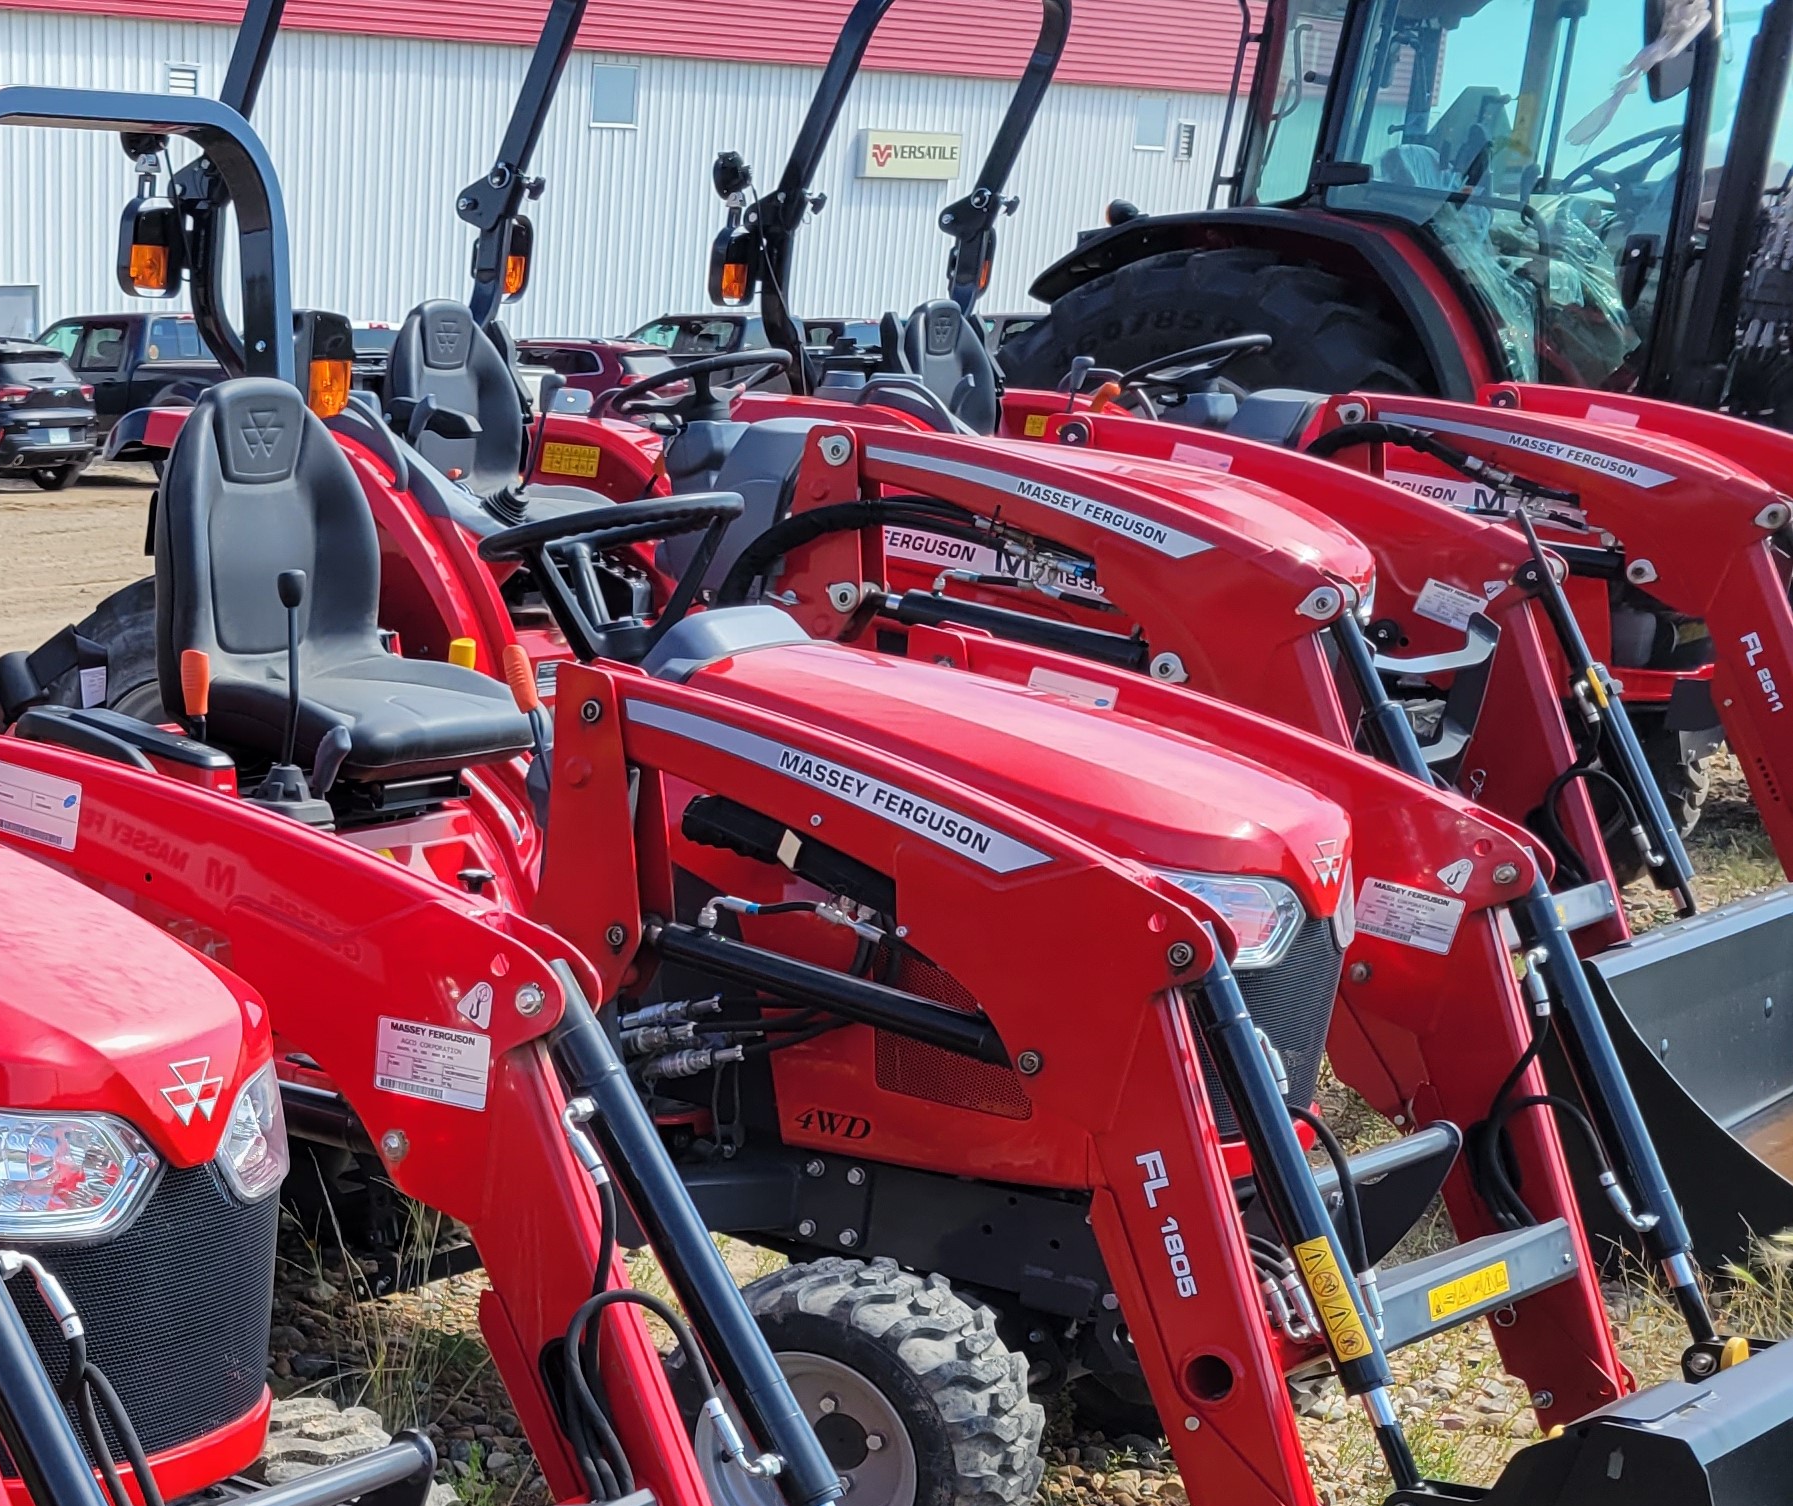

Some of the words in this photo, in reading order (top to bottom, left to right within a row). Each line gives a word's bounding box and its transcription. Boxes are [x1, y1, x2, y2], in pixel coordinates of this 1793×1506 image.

[893, 145, 958, 160] VERSATILE
[1508, 434, 1565, 456] MASSEY
[1566, 449, 1638, 479] FERGUSON
[1017, 481, 1081, 512] MASSEY
[1083, 503, 1167, 545] FERGUSON
[1740, 631, 1764, 667] FL
[1756, 667, 1784, 712] 2611
[779, 750, 870, 798] MASSEY
[872, 788, 992, 854] FERGUSON
[1374, 882, 1407, 895] MASSEY
[1408, 891, 1450, 906] FERGUSON
[391, 1022, 427, 1037] MASSEY
[428, 1029, 475, 1046] FERGUSON
[419, 1041, 462, 1056] CORPORATION
[795, 1108, 871, 1139] 4WD
[1135, 1150, 1170, 1209] FL
[1160, 1216, 1198, 1298] 1805
